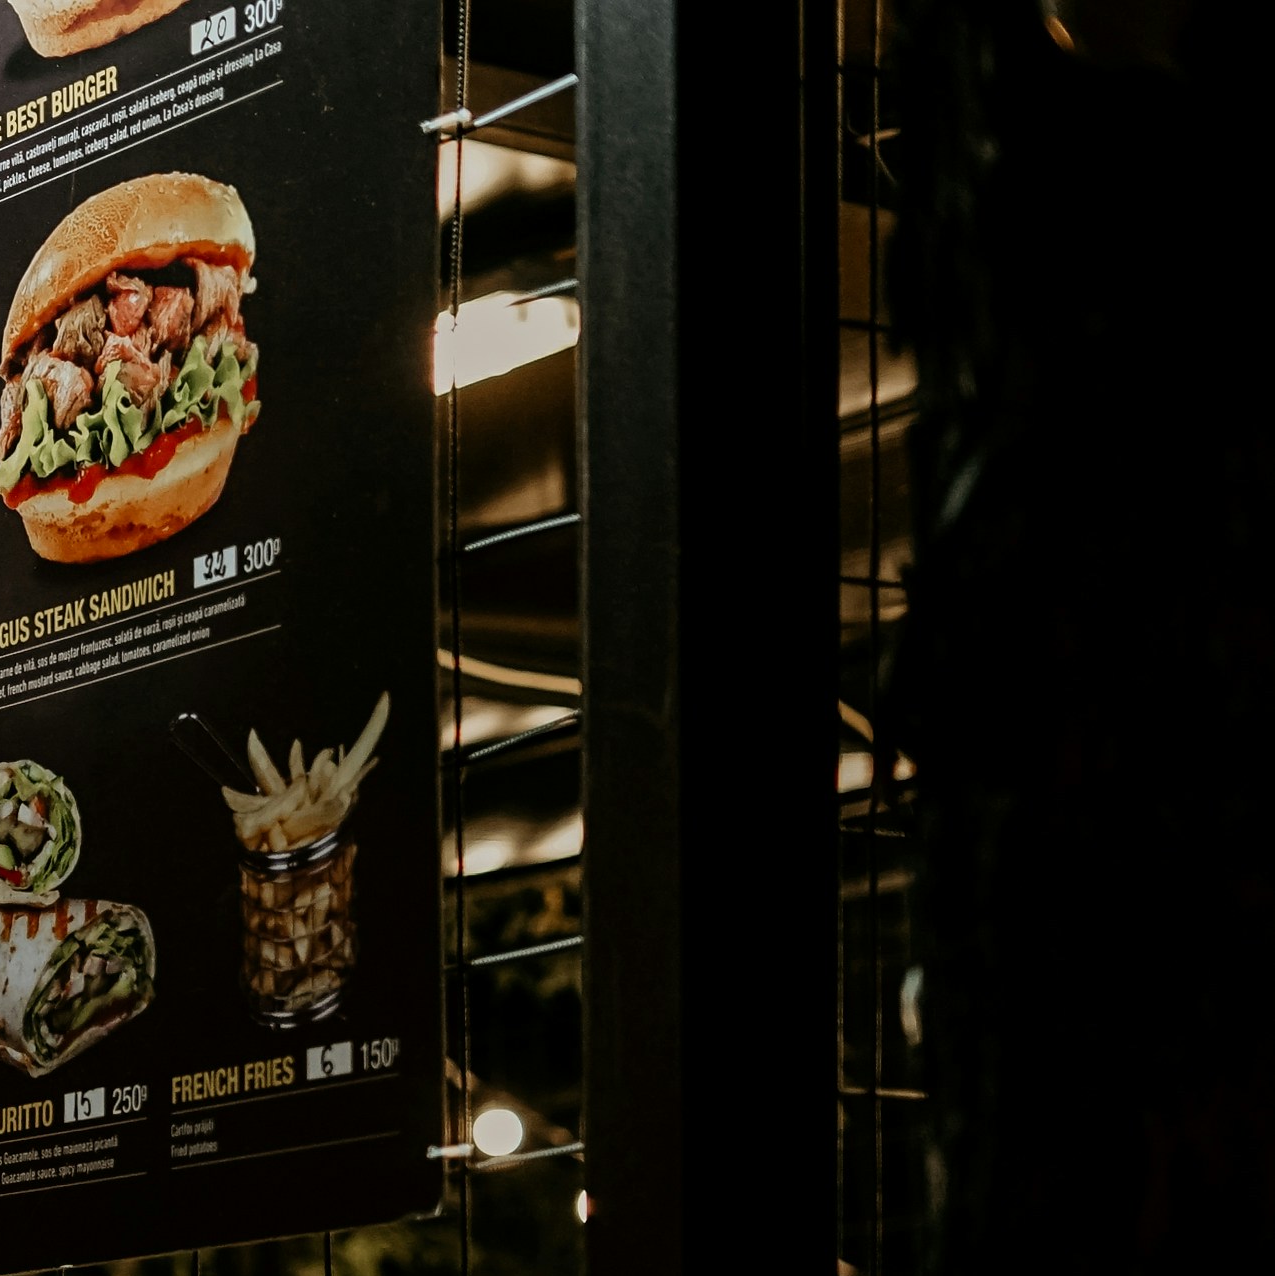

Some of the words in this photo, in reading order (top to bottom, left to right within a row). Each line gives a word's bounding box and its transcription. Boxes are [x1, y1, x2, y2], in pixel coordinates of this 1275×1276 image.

[223, 52, 253, 74] dressing
[254, 47, 263, 61] La
[263, 41, 281, 57] Casa
[6, 95, 47, 137] BEST
[51, 65, 117, 118] BURGER
[84, 136, 108, 154] iceberg
[129, 119, 141, 135] red
[162, 108, 171, 121] La
[171, 97, 194, 117] Casa's
[194, 86, 224, 107] dressing
[34, 597, 85, 638] STEAK
[89, 569, 174, 621] SANDWICH
[6, 679, 27, 695] french
[27, 671, 53, 690] mustard
[74, 660, 101, 676] cabbage
[152, 630, 190, 653] caramelized
[191, 626, 210, 641] onion
[13, 662, 22, 675] de
[36, 656, 48, 668] sos
[48, 651, 57, 664] de
[133, 626, 142, 639] de
[171, 1065, 238, 1104] FRENCH
[244, 1055, 294, 1091] FRIES
